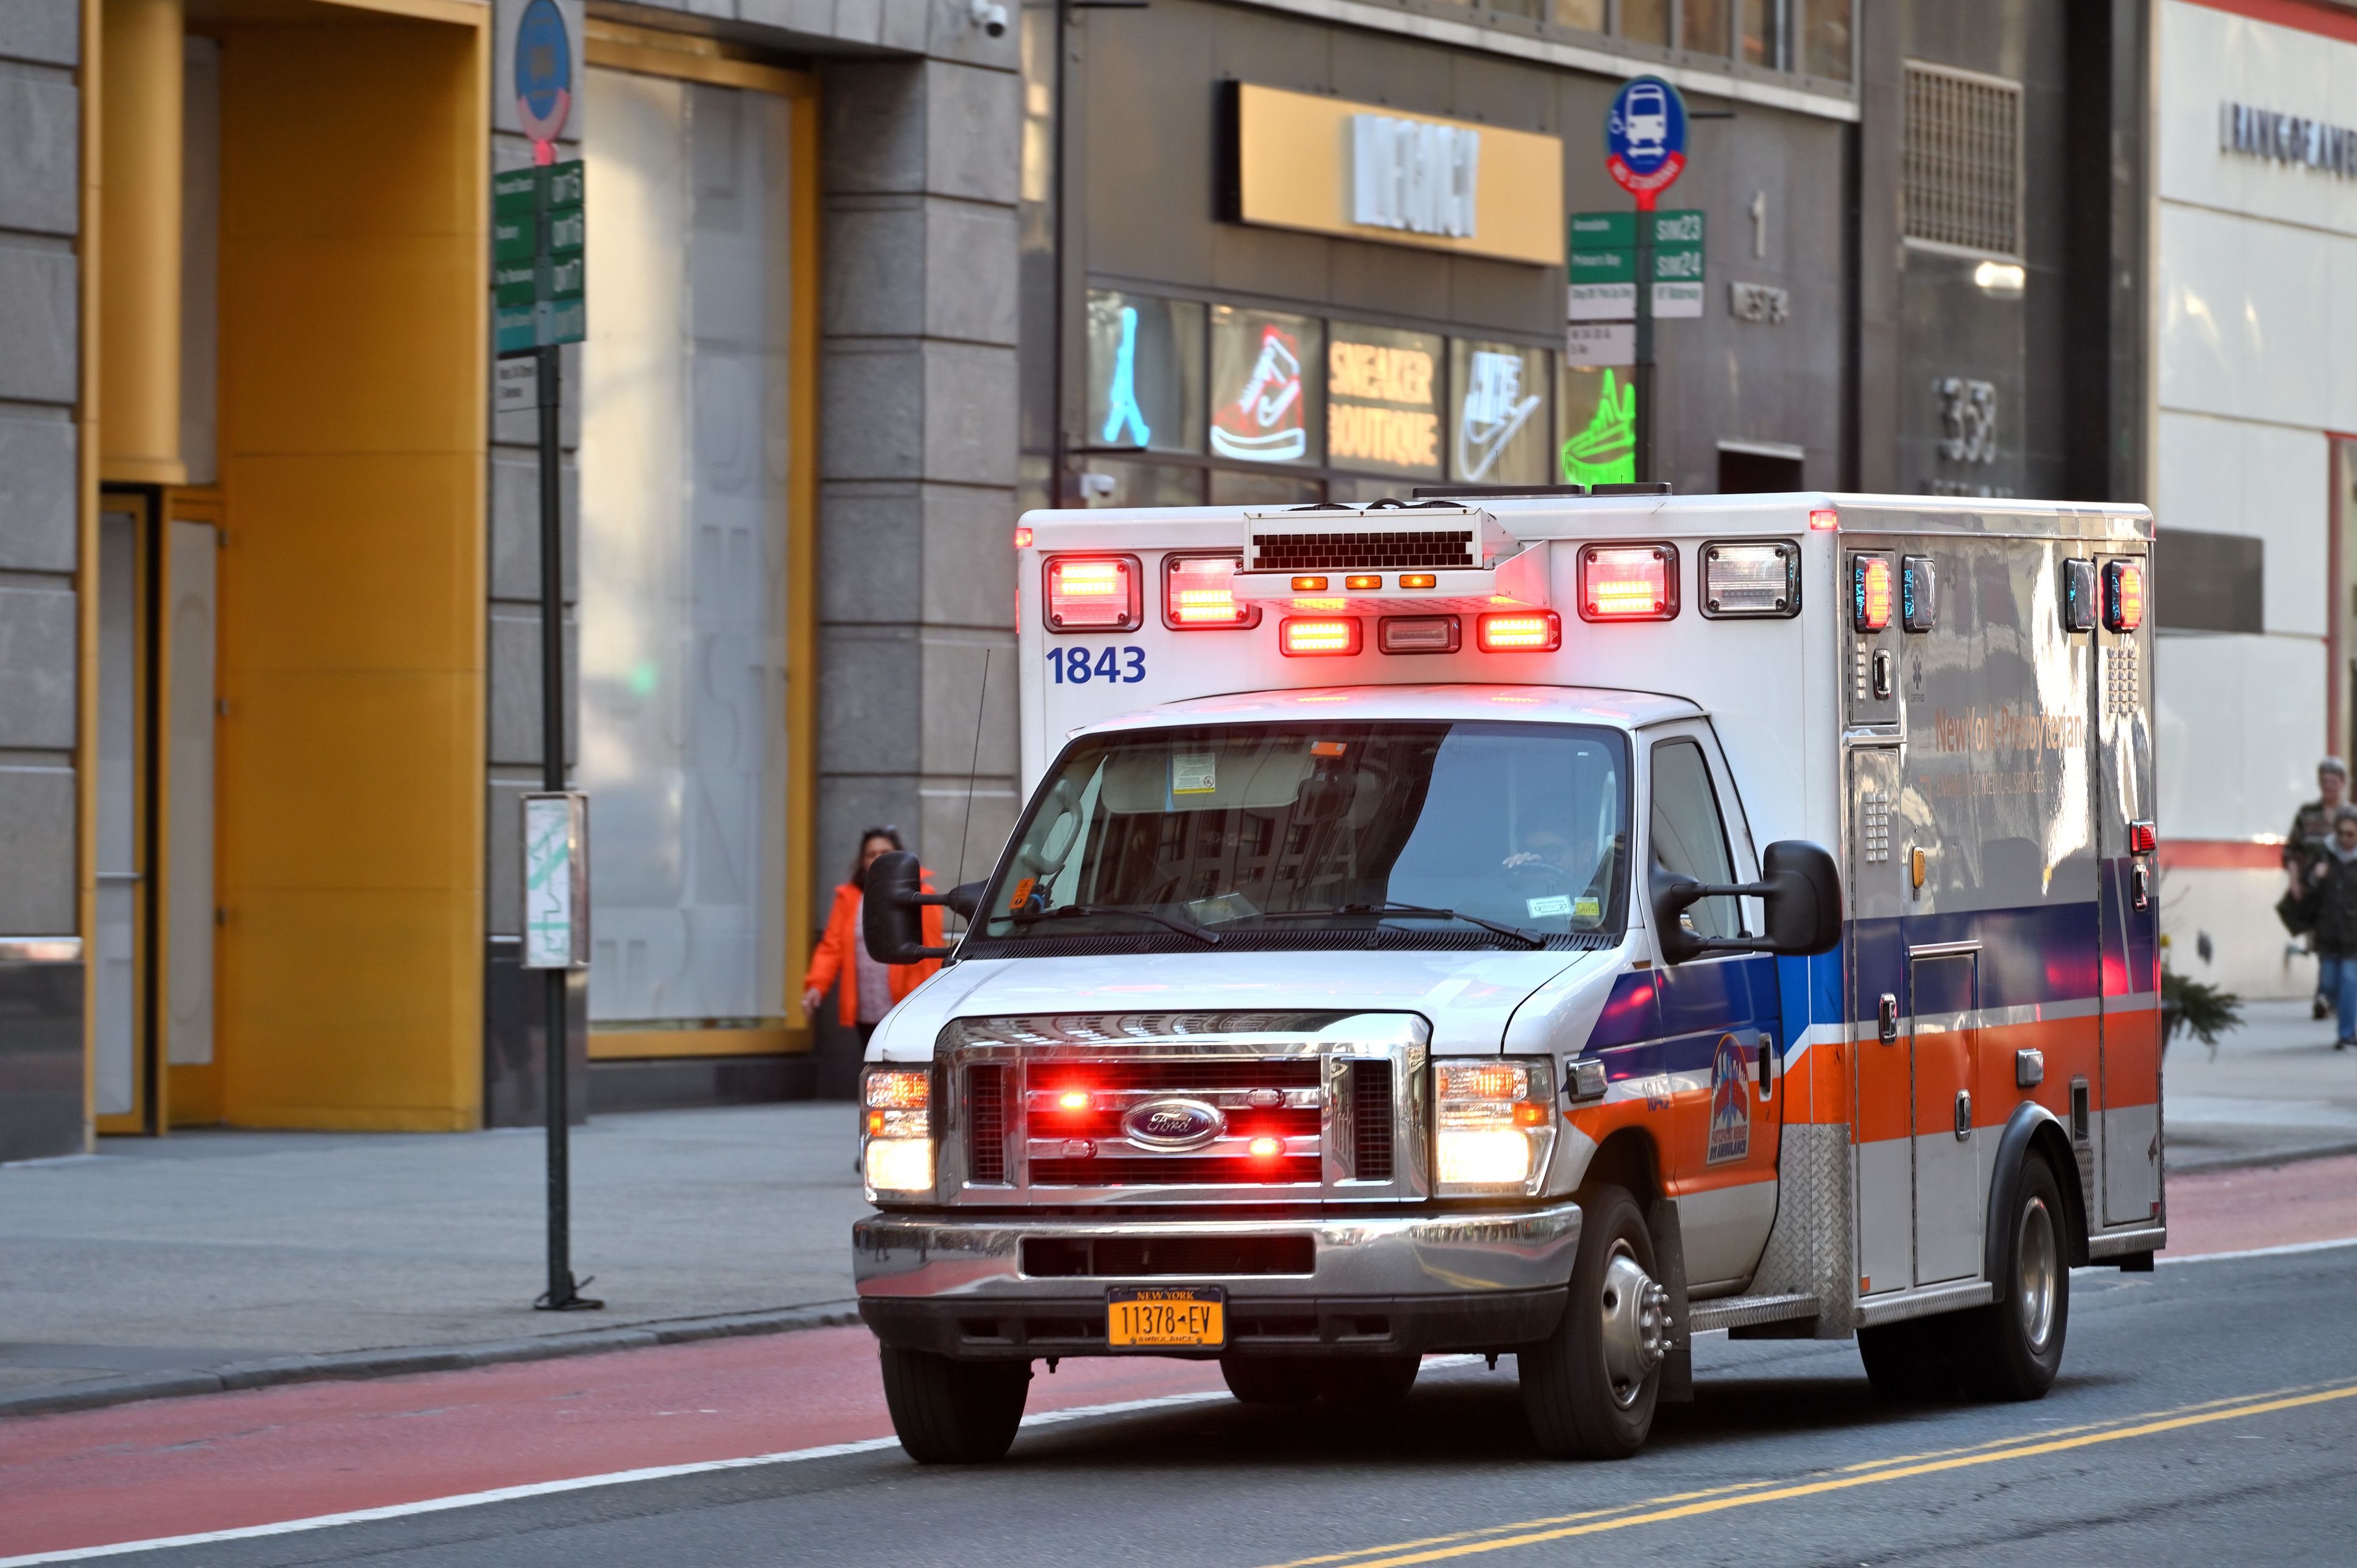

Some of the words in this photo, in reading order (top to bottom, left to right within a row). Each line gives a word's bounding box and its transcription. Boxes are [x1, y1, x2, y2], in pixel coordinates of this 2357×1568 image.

[1329, 340, 1433, 404] SNEAKER
[1328, 403, 1438, 467] BOUTIQUE
[1046, 646, 1146, 683] 1843
[2013, 771, 2045, 794] SERVICES
[1147, 1112, 1192, 1132] Ford
[1137, 1291, 1163, 1301] NEW
[1166, 1291, 1195, 1301] YORK
